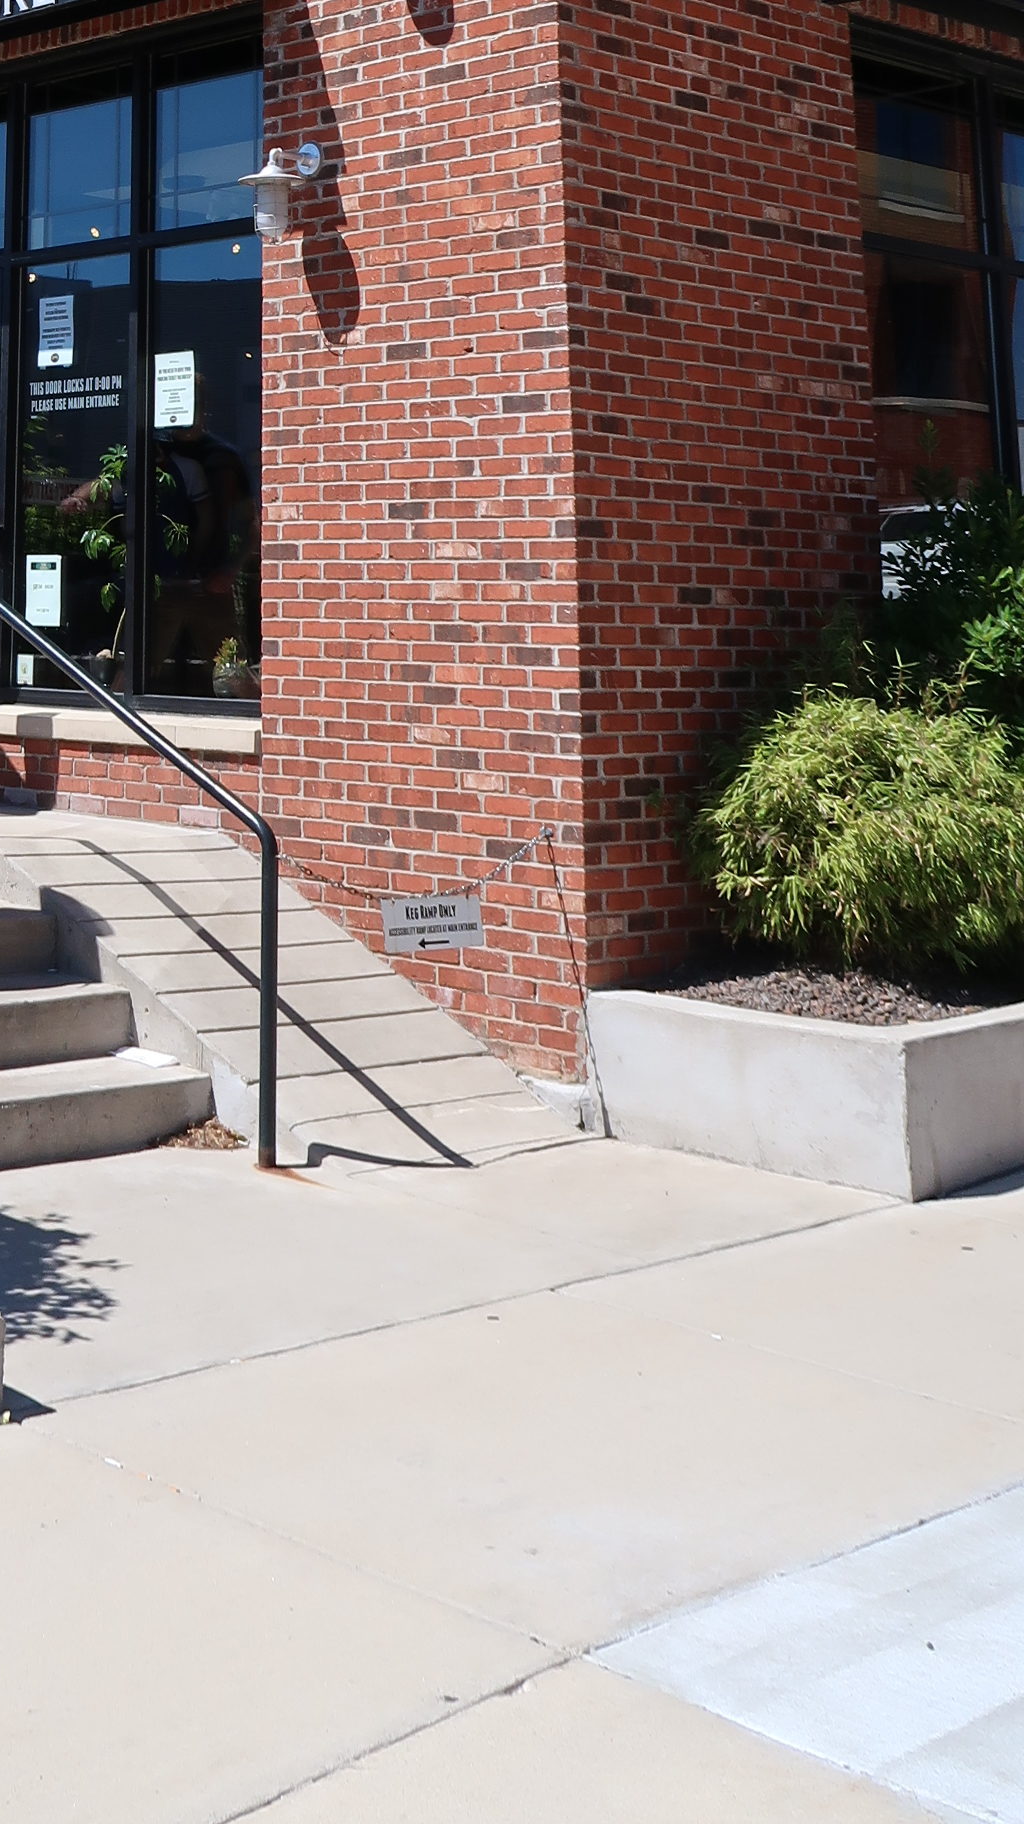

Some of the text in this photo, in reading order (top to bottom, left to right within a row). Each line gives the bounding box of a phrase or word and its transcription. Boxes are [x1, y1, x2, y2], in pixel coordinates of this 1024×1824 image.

[29, 381, 44, 396] THIS
[45, 379, 62, 395] DOOR
[63, 378, 84, 393] LOCKS
[85, 377, 94, 392] AT
[111, 374, 122, 389] PM
[31, 394, 119, 412] PLEASE USE MAIN ENTRANCE
[405, 903, 456, 920] KEG RAMP ONLY
